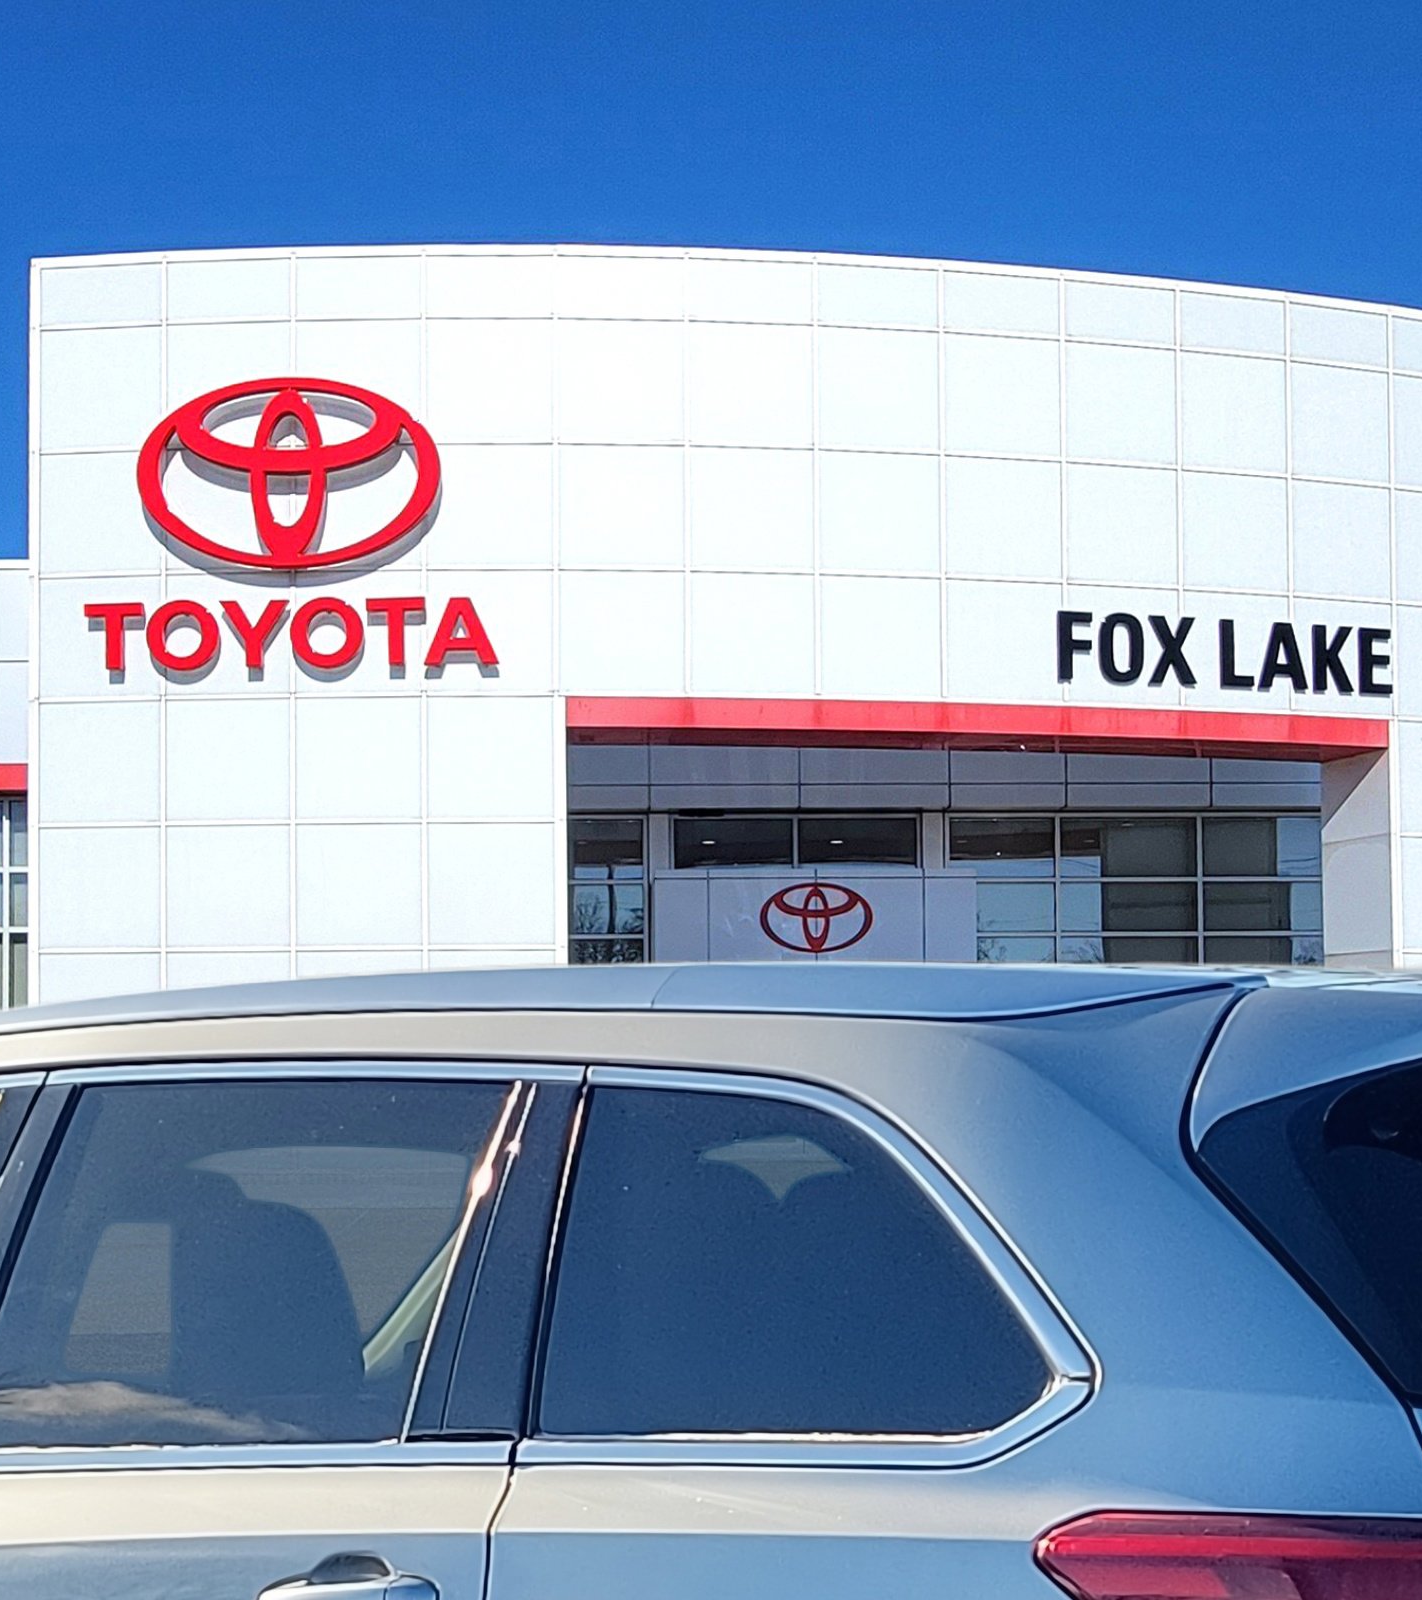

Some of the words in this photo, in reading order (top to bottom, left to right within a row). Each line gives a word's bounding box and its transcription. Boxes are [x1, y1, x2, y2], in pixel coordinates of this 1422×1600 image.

[84, 597, 501, 676] TOYOTA
[1056, 610, 1198, 688] FOX
[1218, 618, 1394, 696] LAKE
